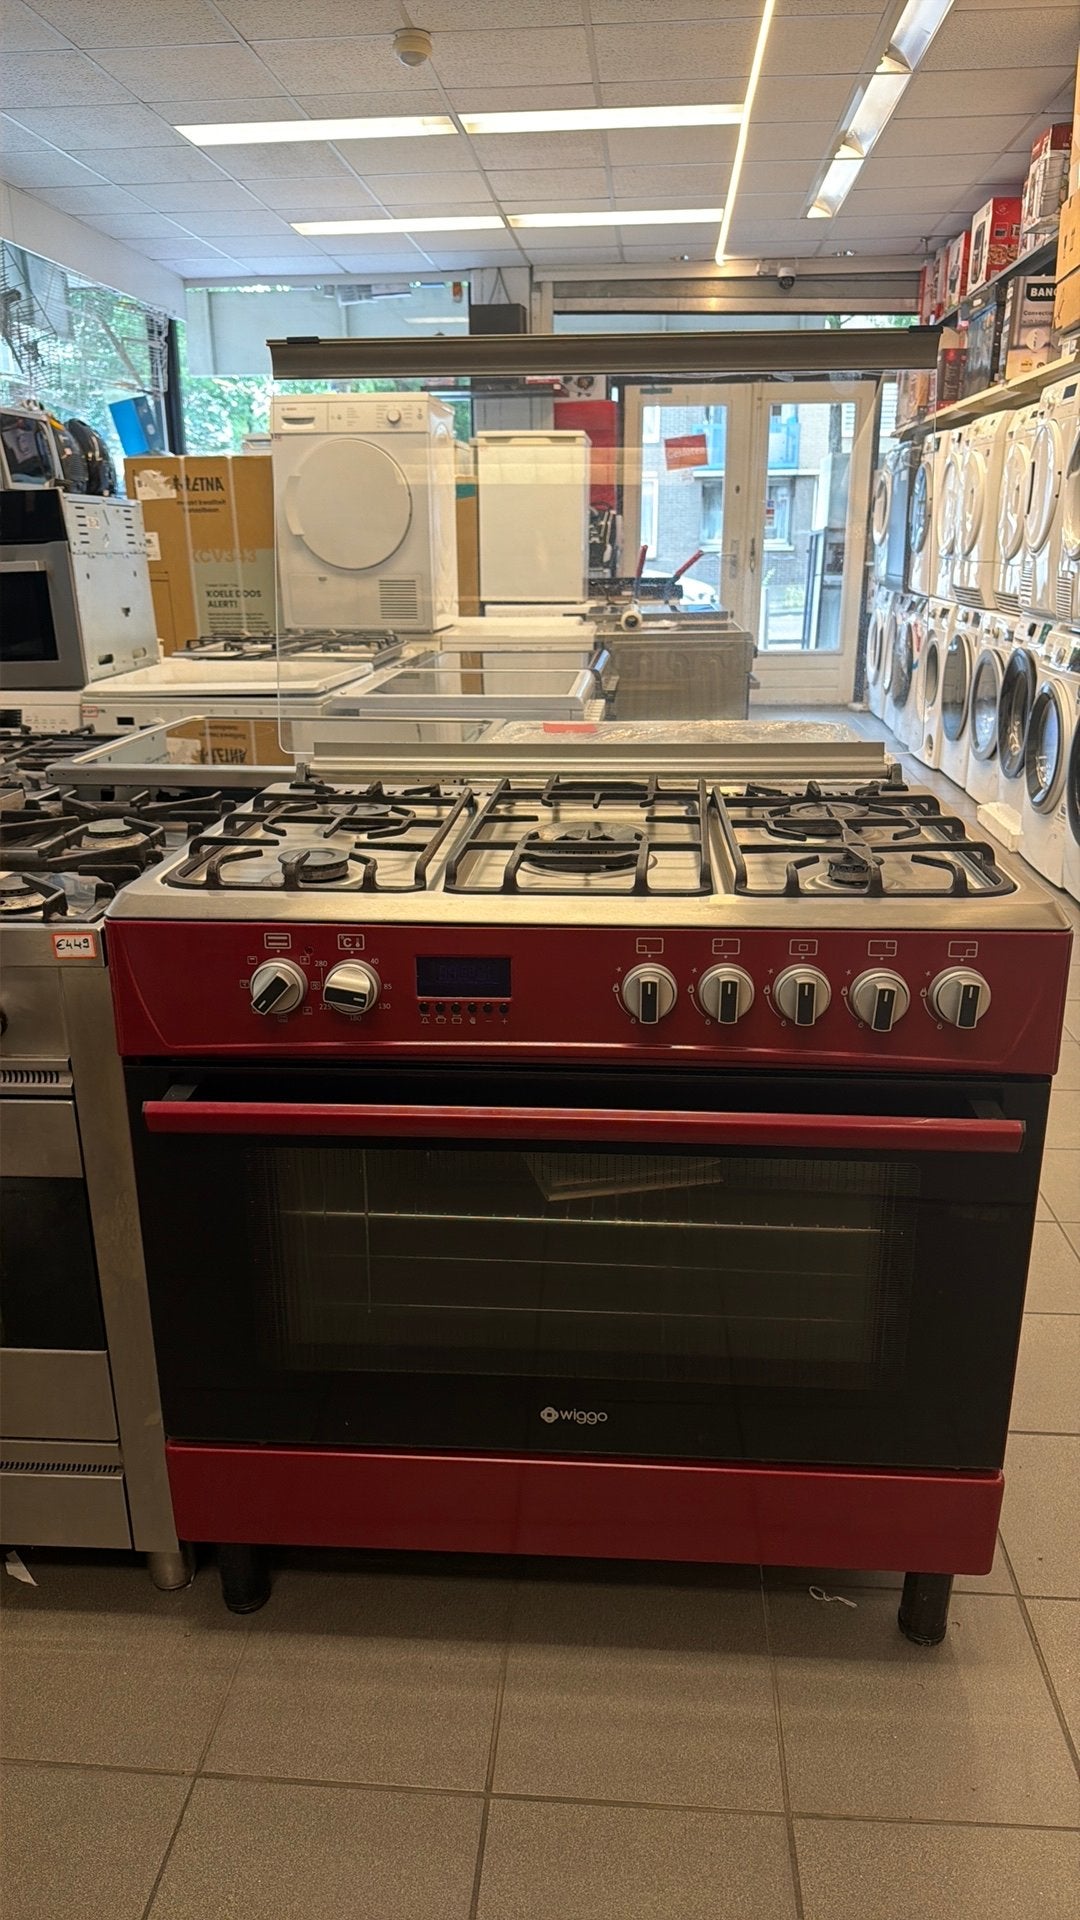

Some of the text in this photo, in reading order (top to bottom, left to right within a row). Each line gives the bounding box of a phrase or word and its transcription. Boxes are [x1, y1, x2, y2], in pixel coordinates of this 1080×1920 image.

[56, 938, 90, 951] €449
[378, 1002, 392, 1010] 130
[560, 1408, 608, 1425] wiggo
